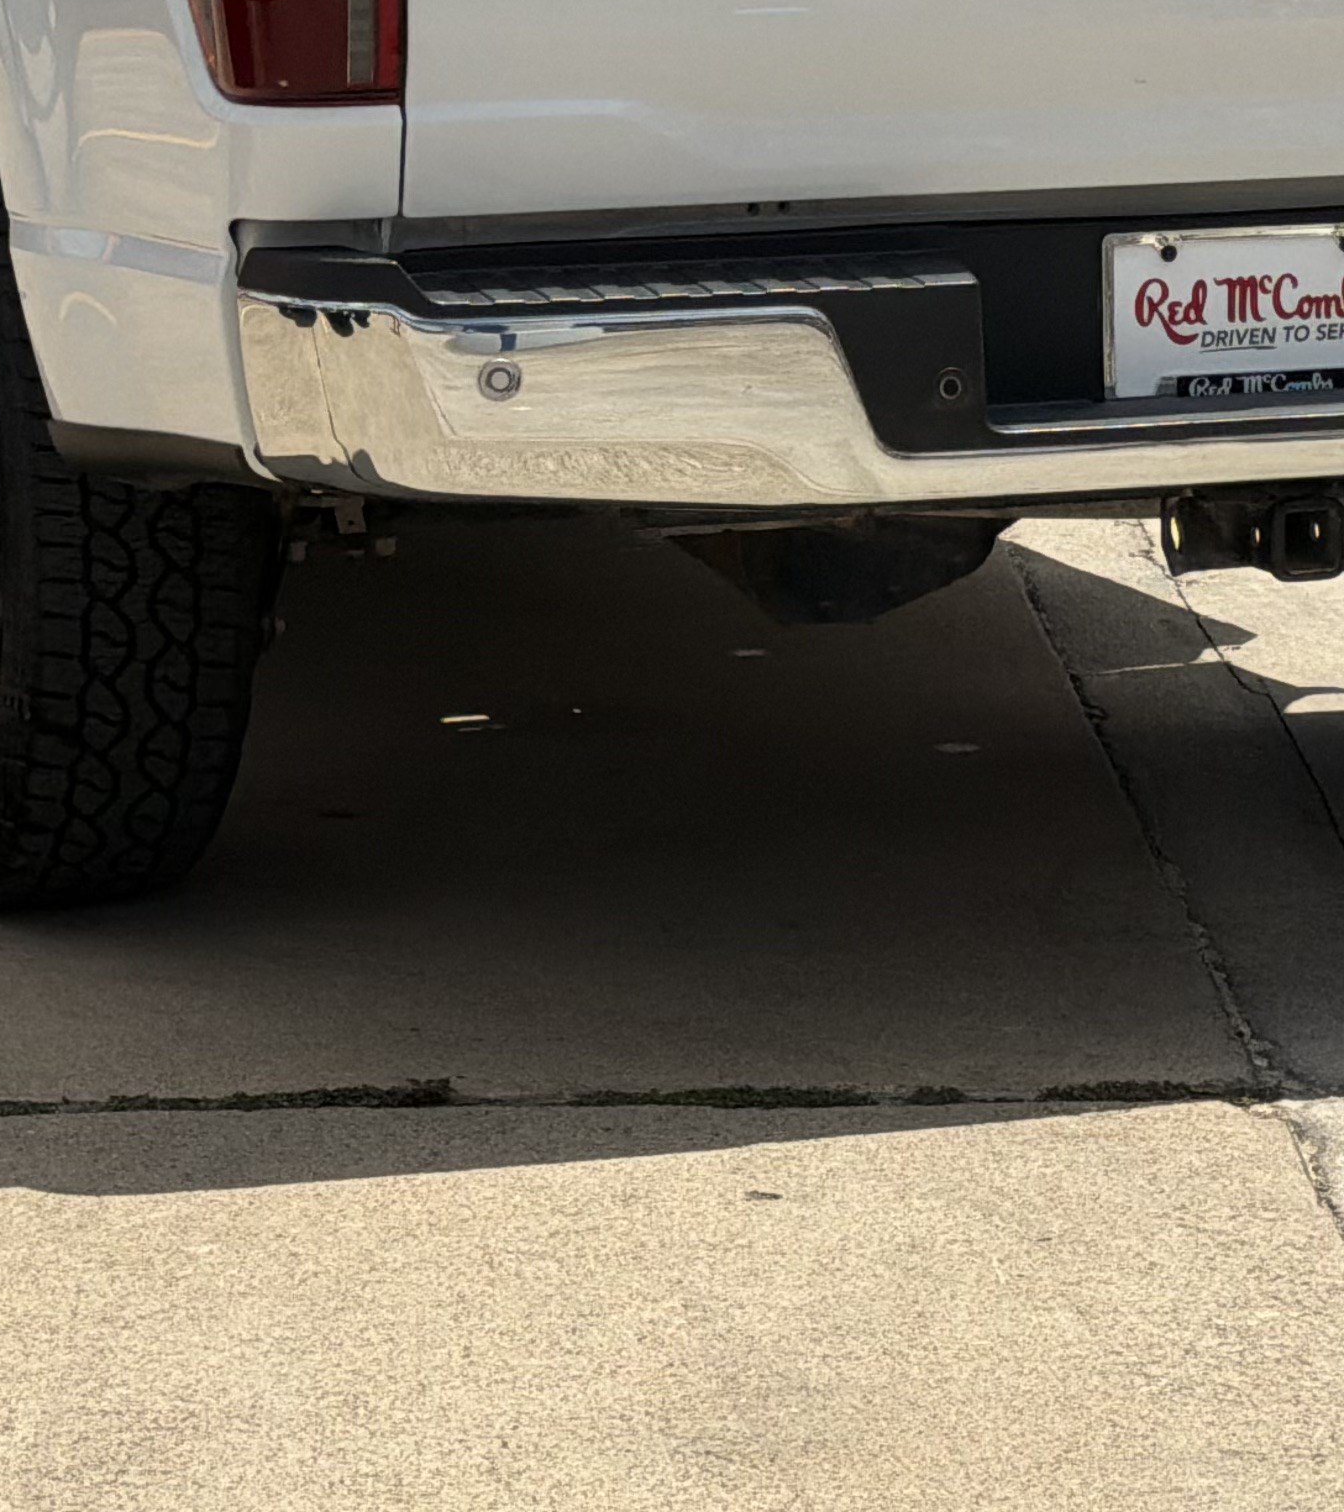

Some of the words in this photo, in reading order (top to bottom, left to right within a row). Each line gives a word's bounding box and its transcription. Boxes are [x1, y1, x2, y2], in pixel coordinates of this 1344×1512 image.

[1134, 277, 1208, 345] Red
[1200, 326, 1277, 349] DRIVEN
[1283, 325, 1311, 343] TO
